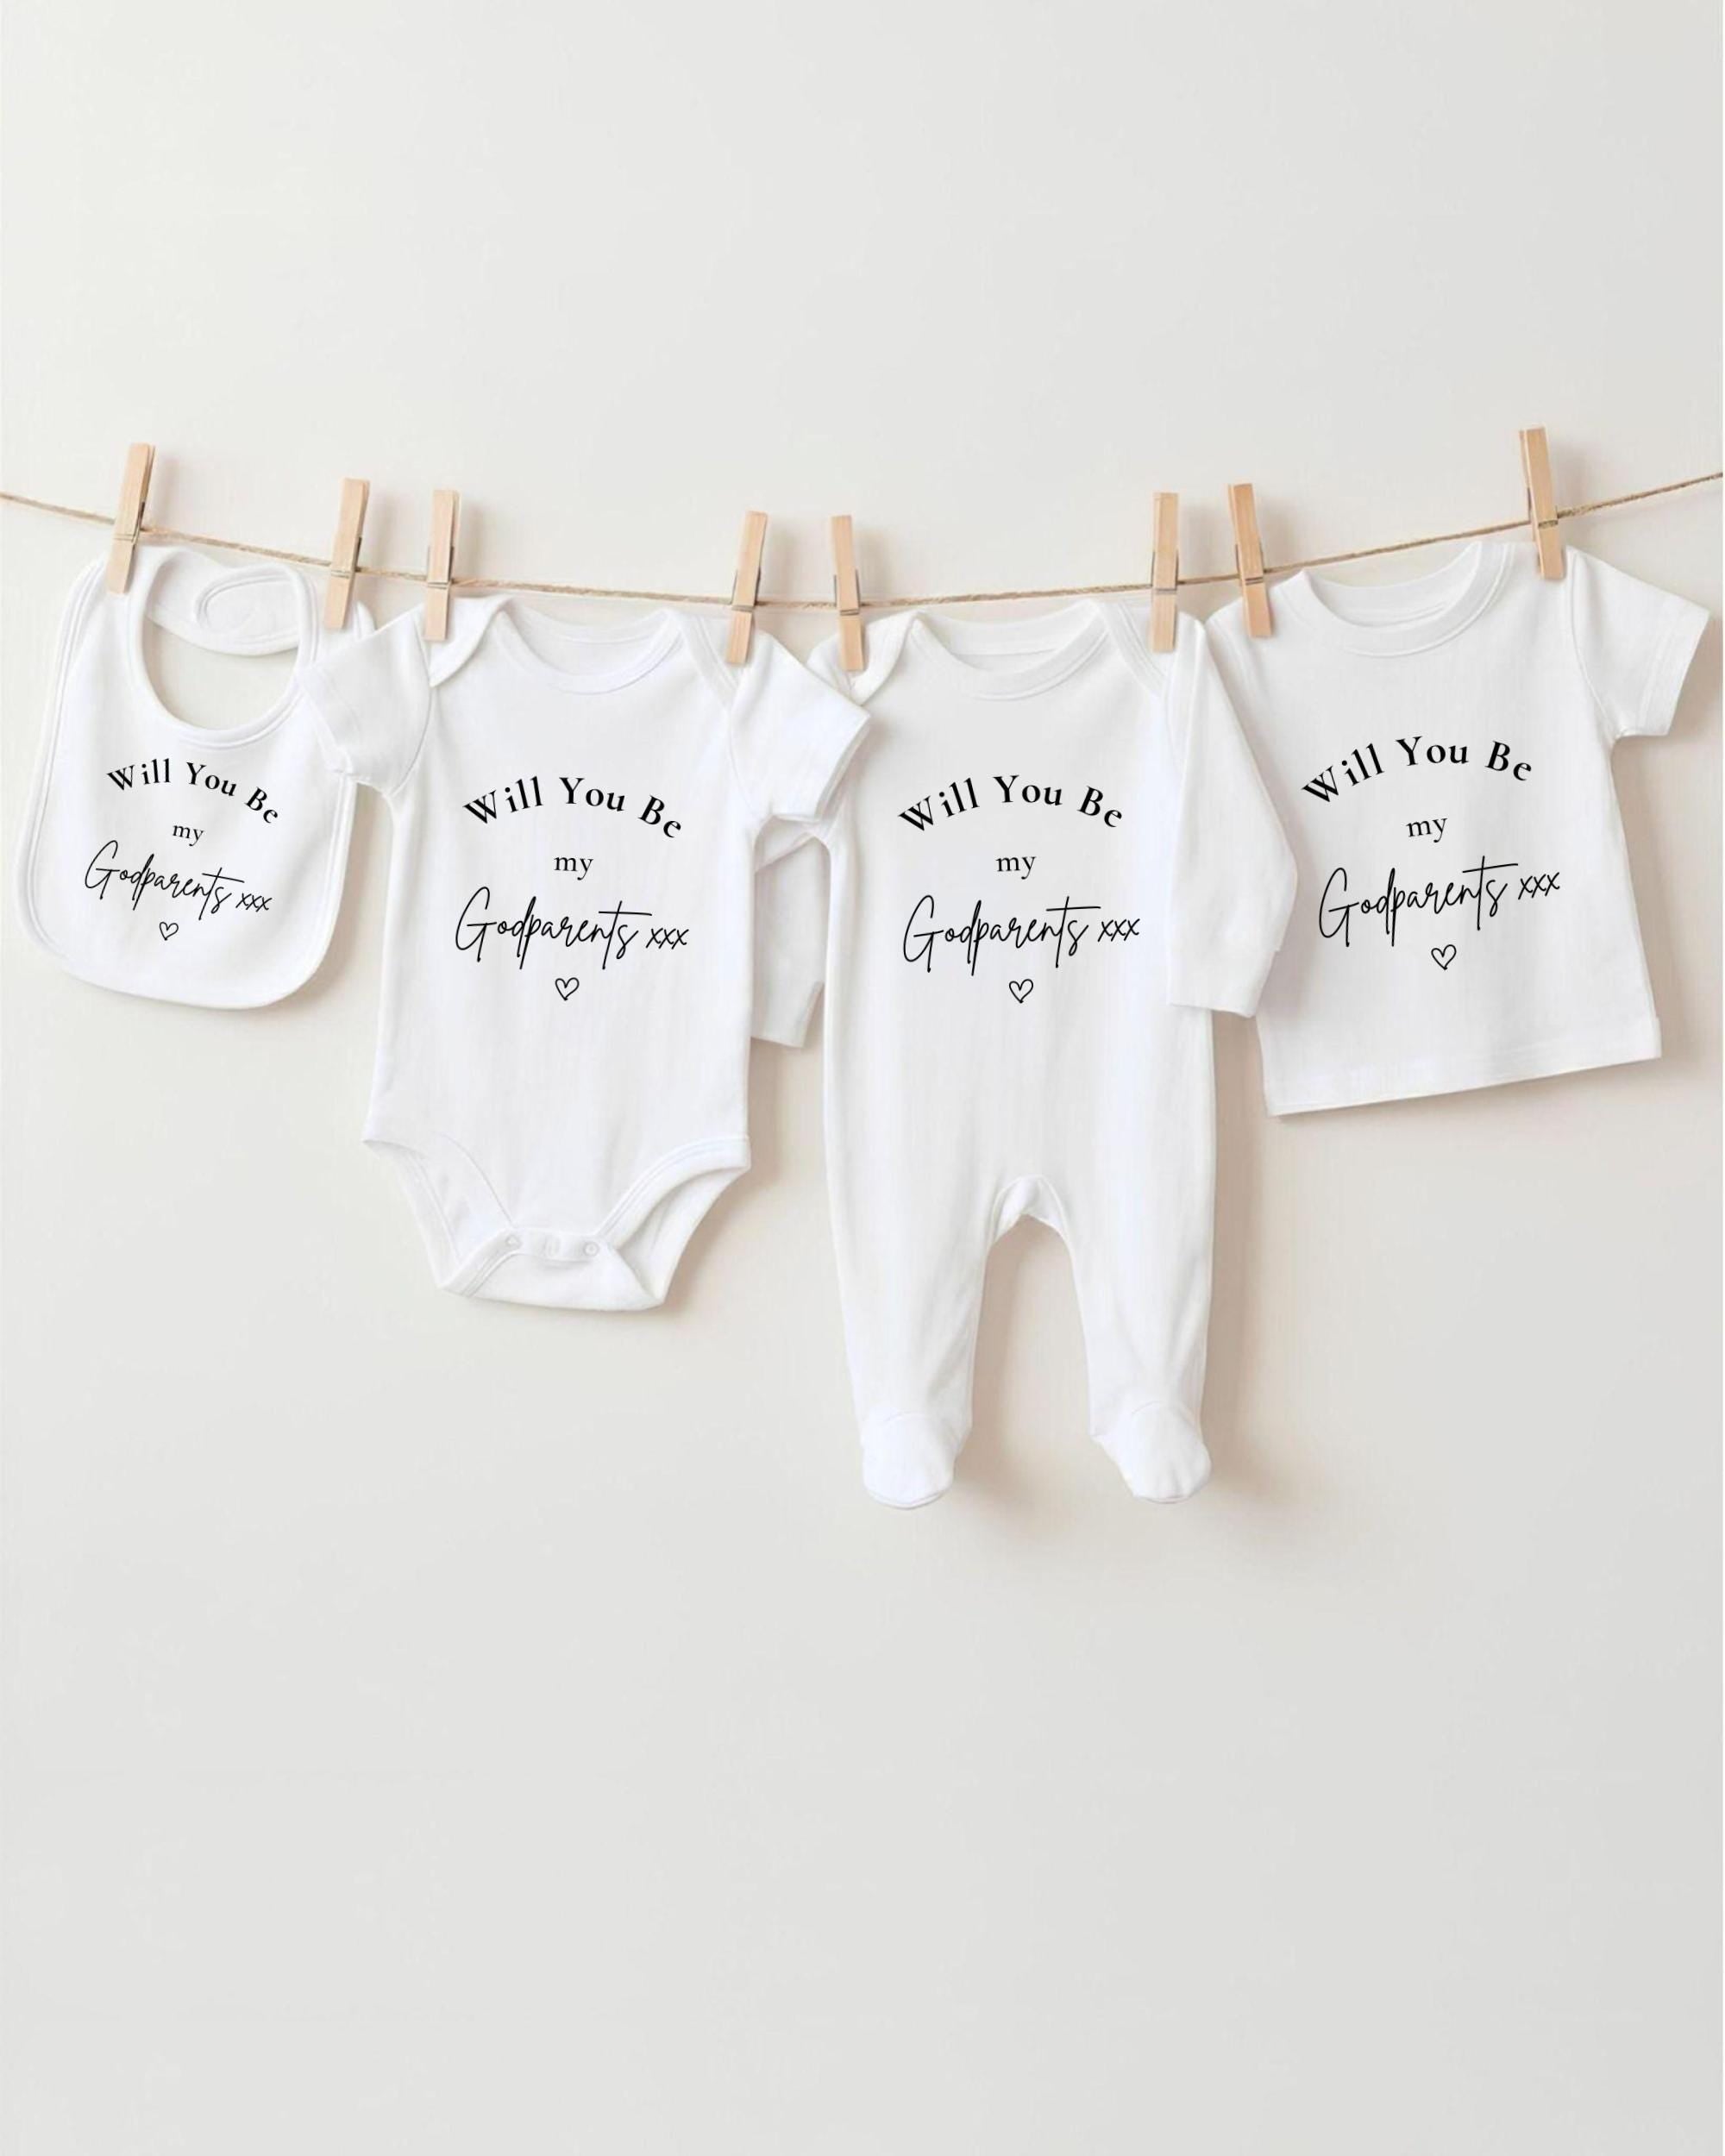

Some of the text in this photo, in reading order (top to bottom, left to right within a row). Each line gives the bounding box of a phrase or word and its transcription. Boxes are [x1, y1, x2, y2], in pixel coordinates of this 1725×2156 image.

[107, 758, 279, 823] Will You Be
[1301, 736, 1532, 803] Will You Be
[463, 776, 682, 838] Will You Be
[898, 775, 1122, 830] Will You Be
[1407, 818, 1448, 843] my
[173, 825, 204, 847] my
[85, 839, 273, 921] Godparents xxx
[554, 856, 594, 881] my
[995, 856, 1036, 881] my
[455, 886, 690, 970] Godparents xxx
[1318, 855, 1560, 948] Godparents xxx
[902, 894, 1141, 977] Godparents xxx
